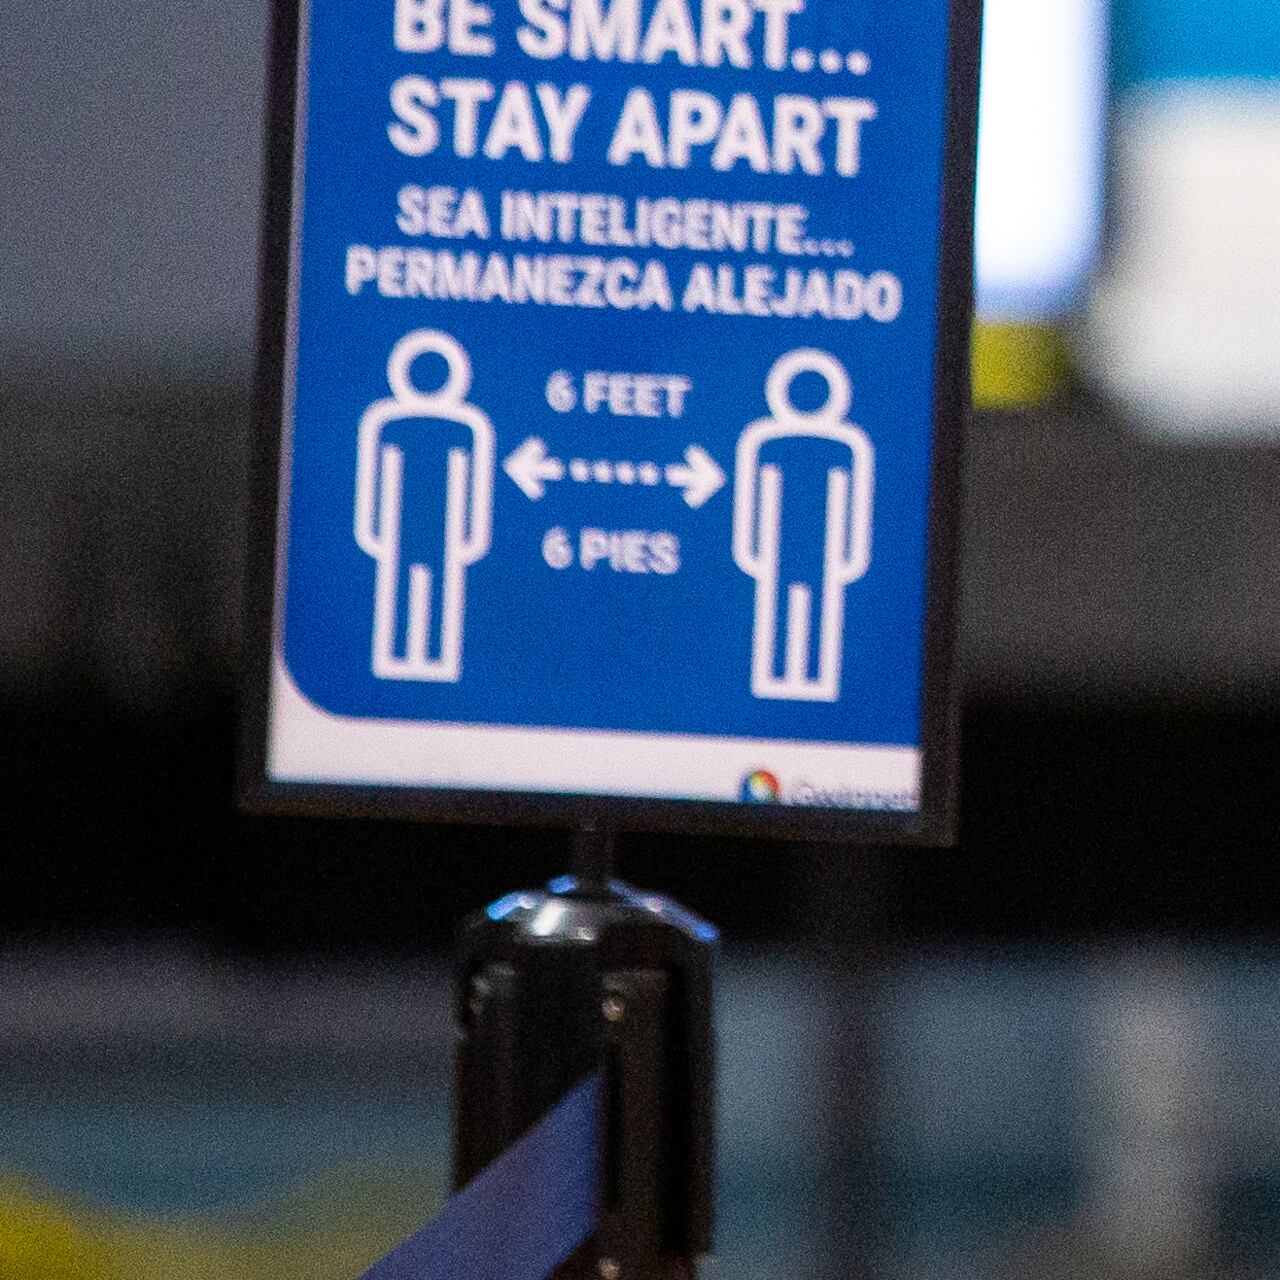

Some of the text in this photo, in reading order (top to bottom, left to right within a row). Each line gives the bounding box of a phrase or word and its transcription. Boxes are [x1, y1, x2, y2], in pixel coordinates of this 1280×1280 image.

[387, 75, 877, 177] STAY APART
[396, 185, 854, 258] SEA INTELIGENTE...
[345, 245, 903, 322] PERMANEZCA ALEJADO
[545, 370, 692, 418] 6 FEET
[542, 526, 680, 575] 6 PIES
